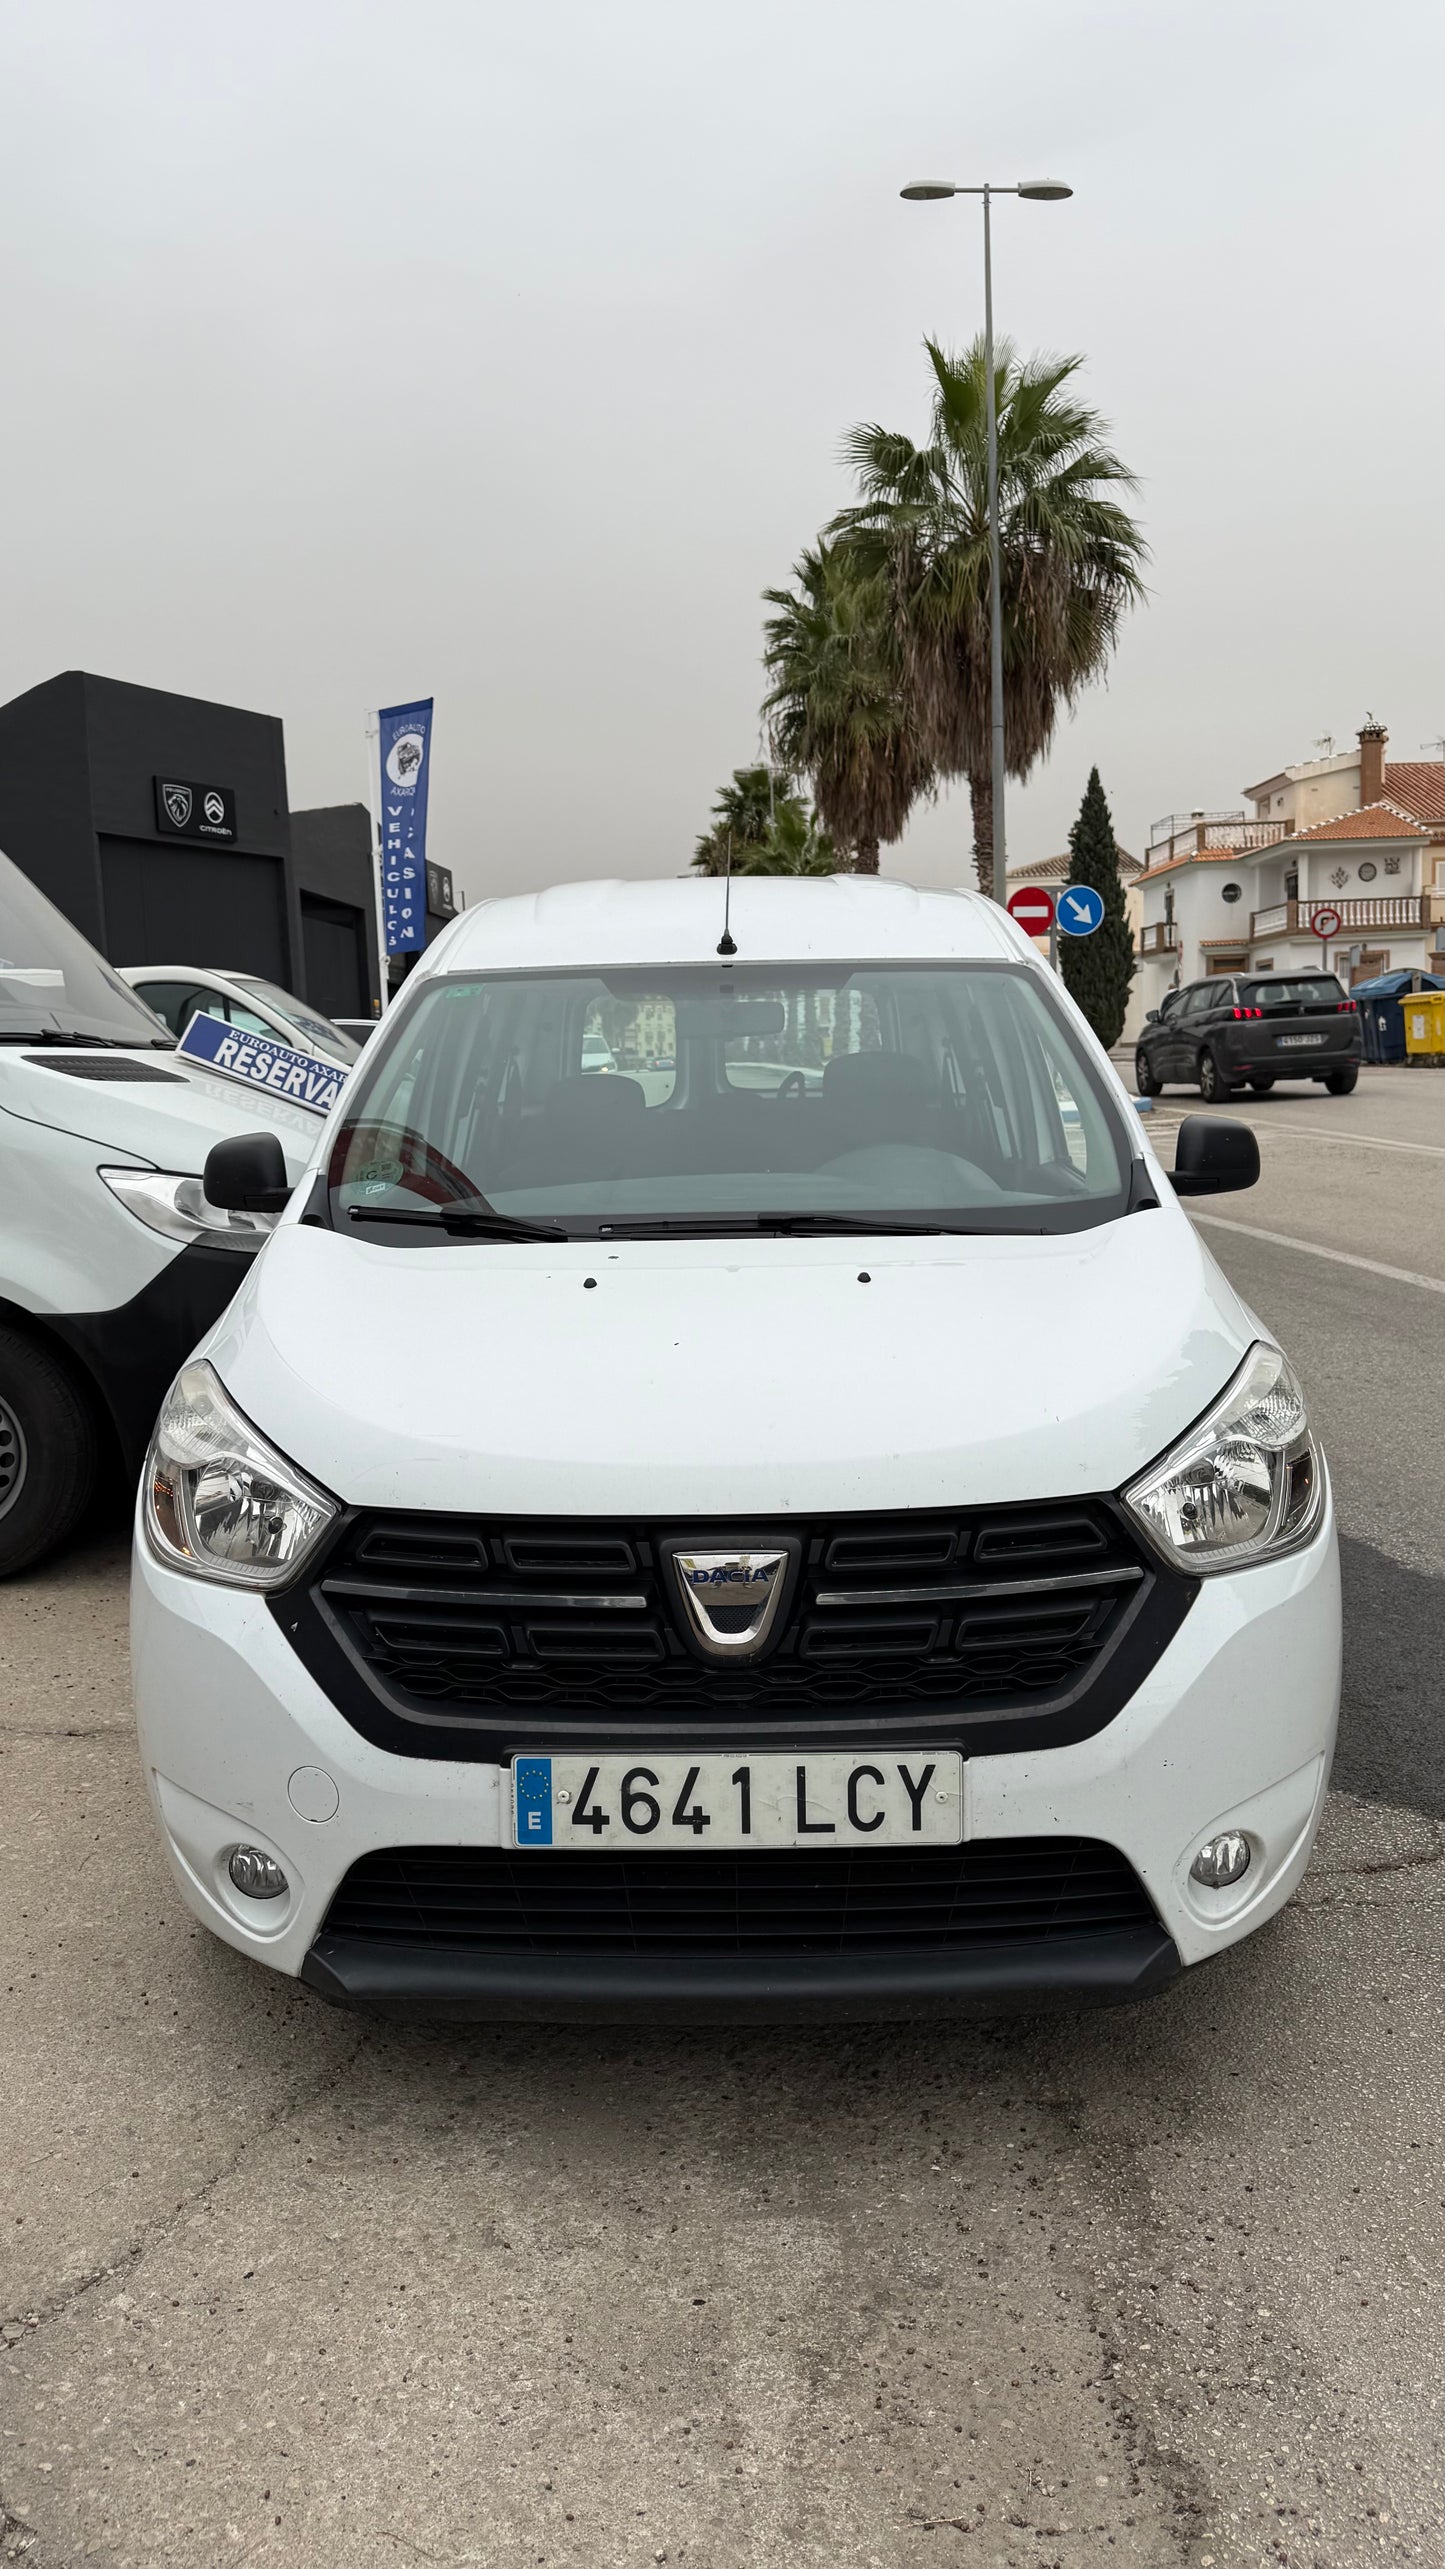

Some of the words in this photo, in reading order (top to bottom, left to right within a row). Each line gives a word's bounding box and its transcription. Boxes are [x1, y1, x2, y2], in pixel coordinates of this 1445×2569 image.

[229, 1029, 308, 1068] EUROAUTO
[213, 1037, 337, 1110] RESERVA
[692, 1568, 769, 1584] DACIA
[572, 1766, 750, 1835] 4641
[796, 1764, 937, 1833] LCY
[527, 1811, 542, 1830] E
